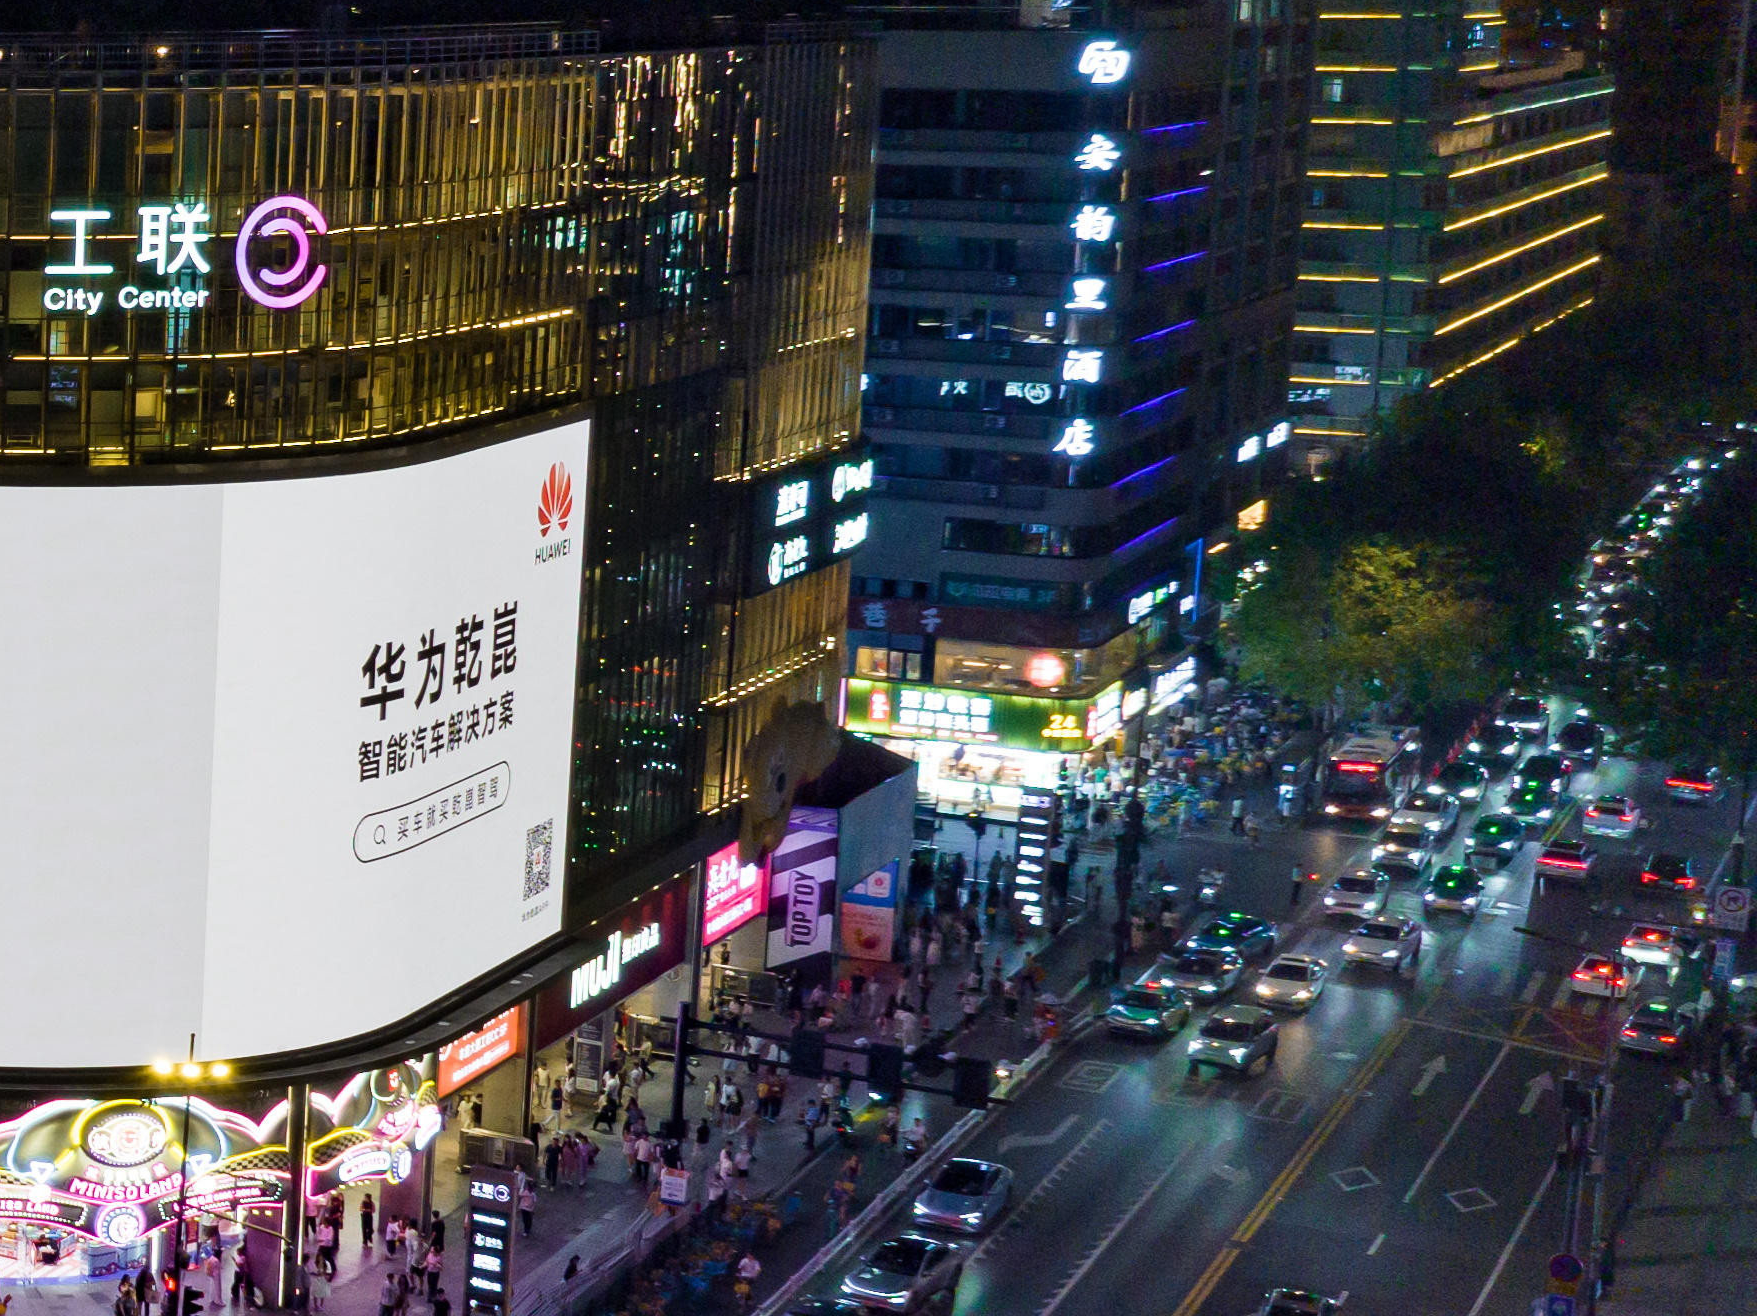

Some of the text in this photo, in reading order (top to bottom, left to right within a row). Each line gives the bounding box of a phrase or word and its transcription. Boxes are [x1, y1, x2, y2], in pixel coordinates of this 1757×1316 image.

[45, 202, 210, 275] 工联
[44, 286, 209, 315] City Center
[535, 540, 571, 566] HUAWEI
[360, 601, 518, 721] 华为乾崑
[358, 691, 515, 782] 智能汽车解决方案
[1050, 715, 1078, 729] 24
[790, 871, 815, 946] TOP TOY
[570, 930, 621, 1008] MUJI
[26, 1201, 59, 1215] LAND
[70, 1178, 138, 1200] MINISO
[140, 1172, 183, 1199] LAND
